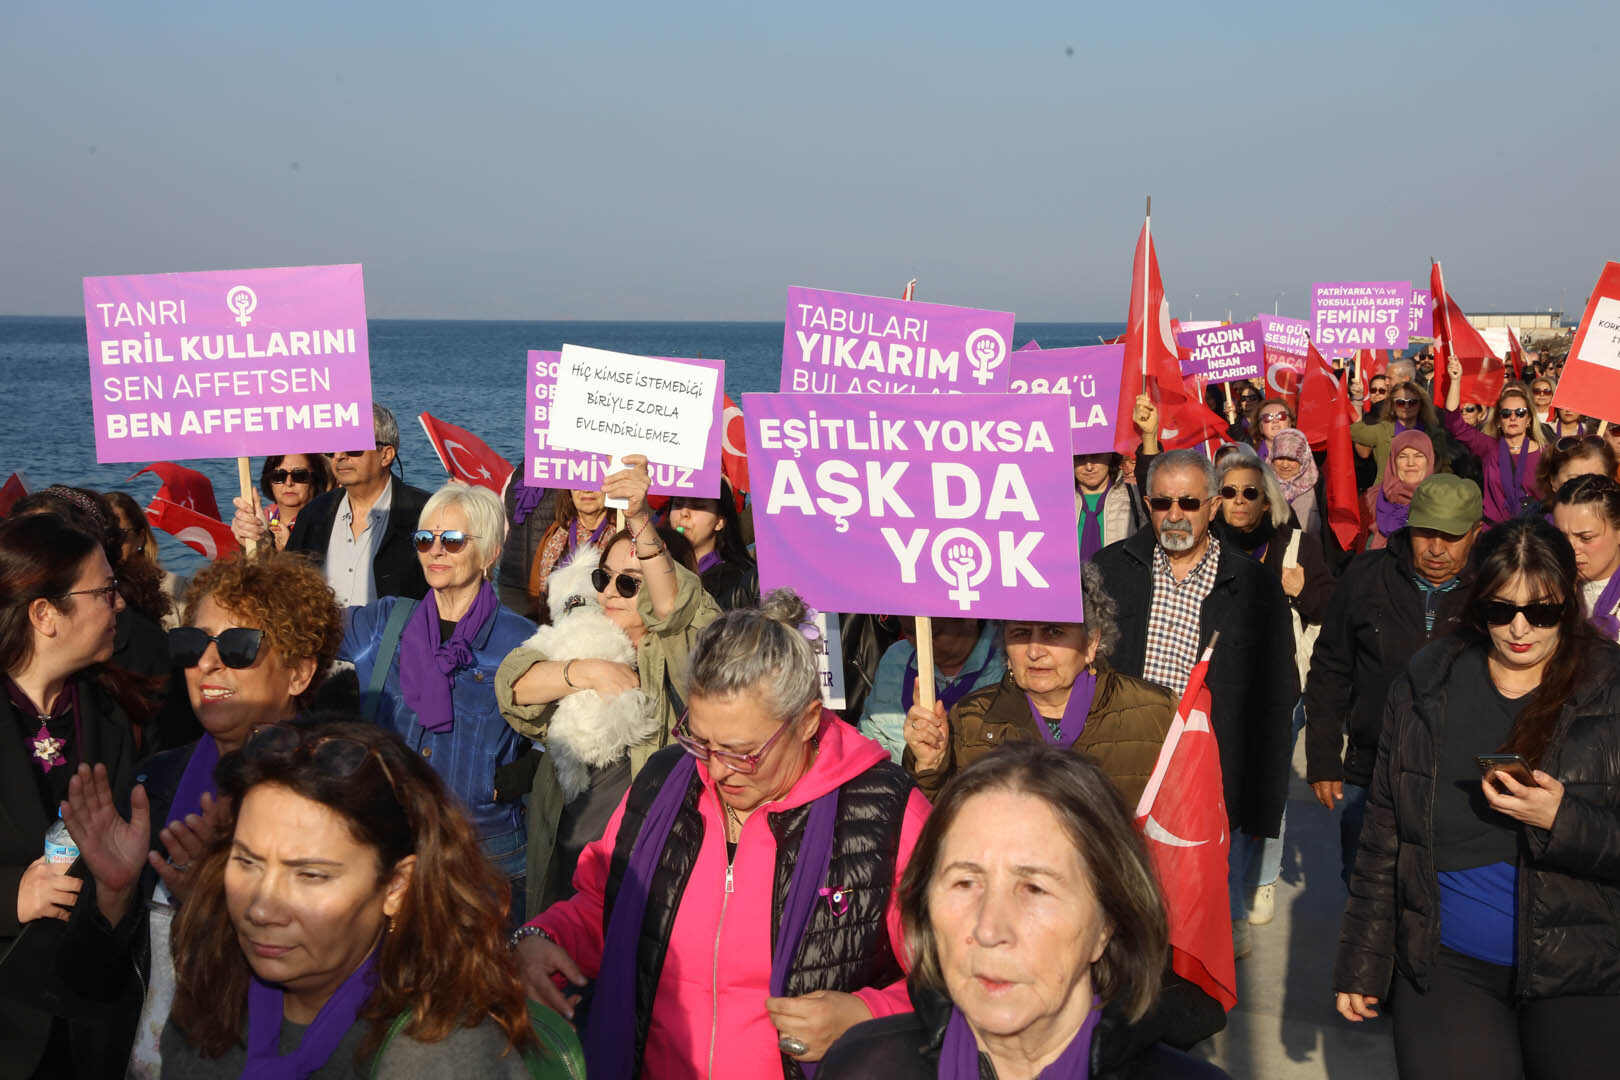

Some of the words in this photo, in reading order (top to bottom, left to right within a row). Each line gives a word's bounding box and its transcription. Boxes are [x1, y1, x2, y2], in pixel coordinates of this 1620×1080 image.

[97, 300, 186, 327] TANRI
[1316, 306, 1399, 325] FEMİNİST
[1317, 297, 1375, 307] YOKSULLUĞA
[1376, 297, 1404, 307] KARŞI
[797, 303, 927, 343] TABULARI
[1196, 327, 1245, 348] KADIN
[1316, 323, 1376, 345] İSYAN
[101, 332, 173, 364] ERİL
[181, 329, 355, 360] KULLARINI
[796, 331, 958, 381] YIKARIM
[1189, 340, 1256, 362] HAKLARI
[104, 376, 162, 401] SEN
[173, 368, 330, 398] AFFETSEN
[571, 361, 591, 382] HİÇ
[594, 366, 633, 387] KİMSE
[635, 370, 704, 399] İSTEMEDİĞİ
[107, 412, 171, 438] BEN
[180, 403, 358, 434] AFFETMEM
[586, 390, 633, 414] BİRİYLE
[634, 400, 680, 420] ZORLA
[577, 418, 680, 445] EVLENDİRİLEMEZ.
[760, 411, 908, 457] EŞİTLİK
[914, 421, 1053, 452] YOKSA
[533, 454, 694, 488] ETMİYRUZ
[765, 459, 916, 534] AŞK
[932, 463, 1040, 520] DA
[881, 528, 1049, 610] YOK
